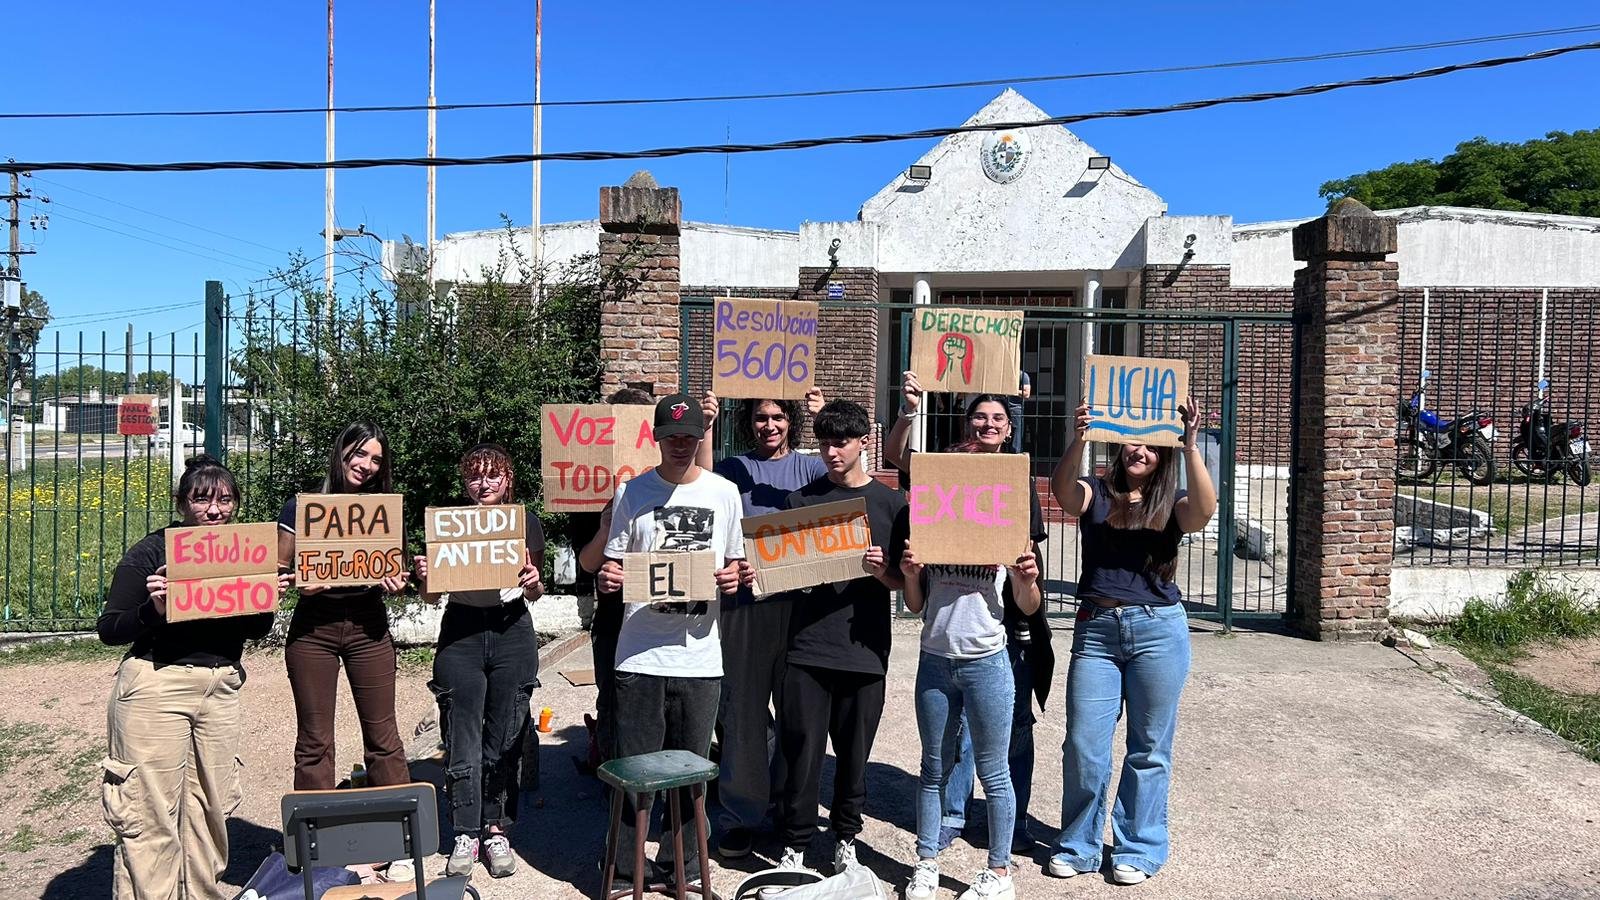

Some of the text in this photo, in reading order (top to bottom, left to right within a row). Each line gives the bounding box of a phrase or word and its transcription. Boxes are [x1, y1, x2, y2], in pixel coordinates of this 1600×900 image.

[716, 301, 818, 337] Resolución
[921, 311, 1022, 338] DERECHOS
[717, 339, 810, 383] 5606
[1088, 365, 1177, 421] LUCHA
[548, 408, 656, 449] VOZ A
[550, 461, 656, 494] TODO
[304, 502, 390, 539] PARA
[434, 508, 516, 537] ESTUDI
[173, 530, 268, 565] Estudio
[433, 540, 520, 568] ANTES
[649, 561, 686, 597] EL
